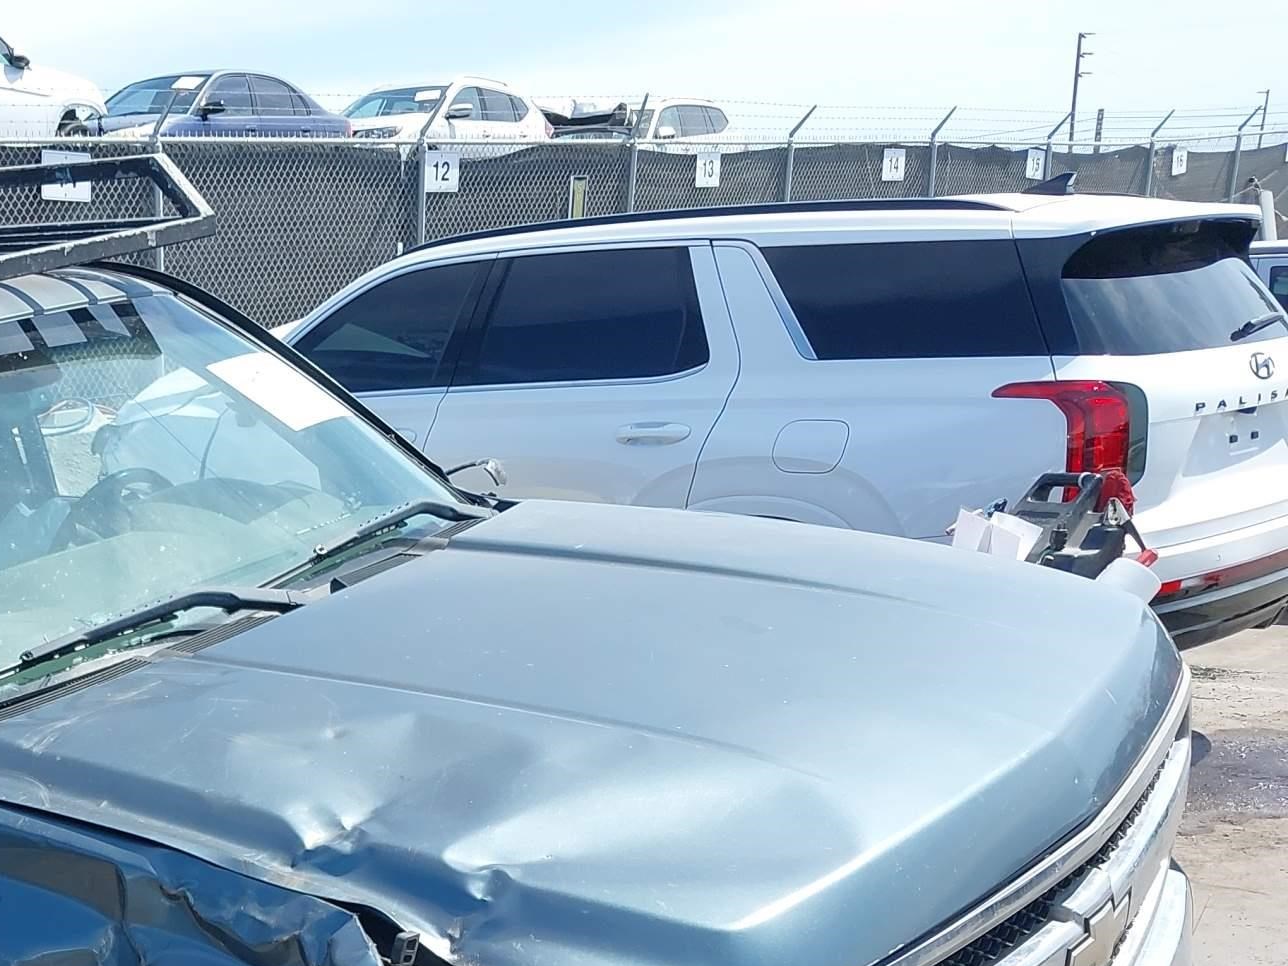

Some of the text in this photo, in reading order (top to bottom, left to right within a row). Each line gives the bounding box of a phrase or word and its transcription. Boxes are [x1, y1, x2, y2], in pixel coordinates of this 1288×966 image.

[432, 161, 450, 182] 12
[702, 159, 714, 178] 13
[889, 157, 899, 173] 14
[1031, 157, 1041, 172] 15
